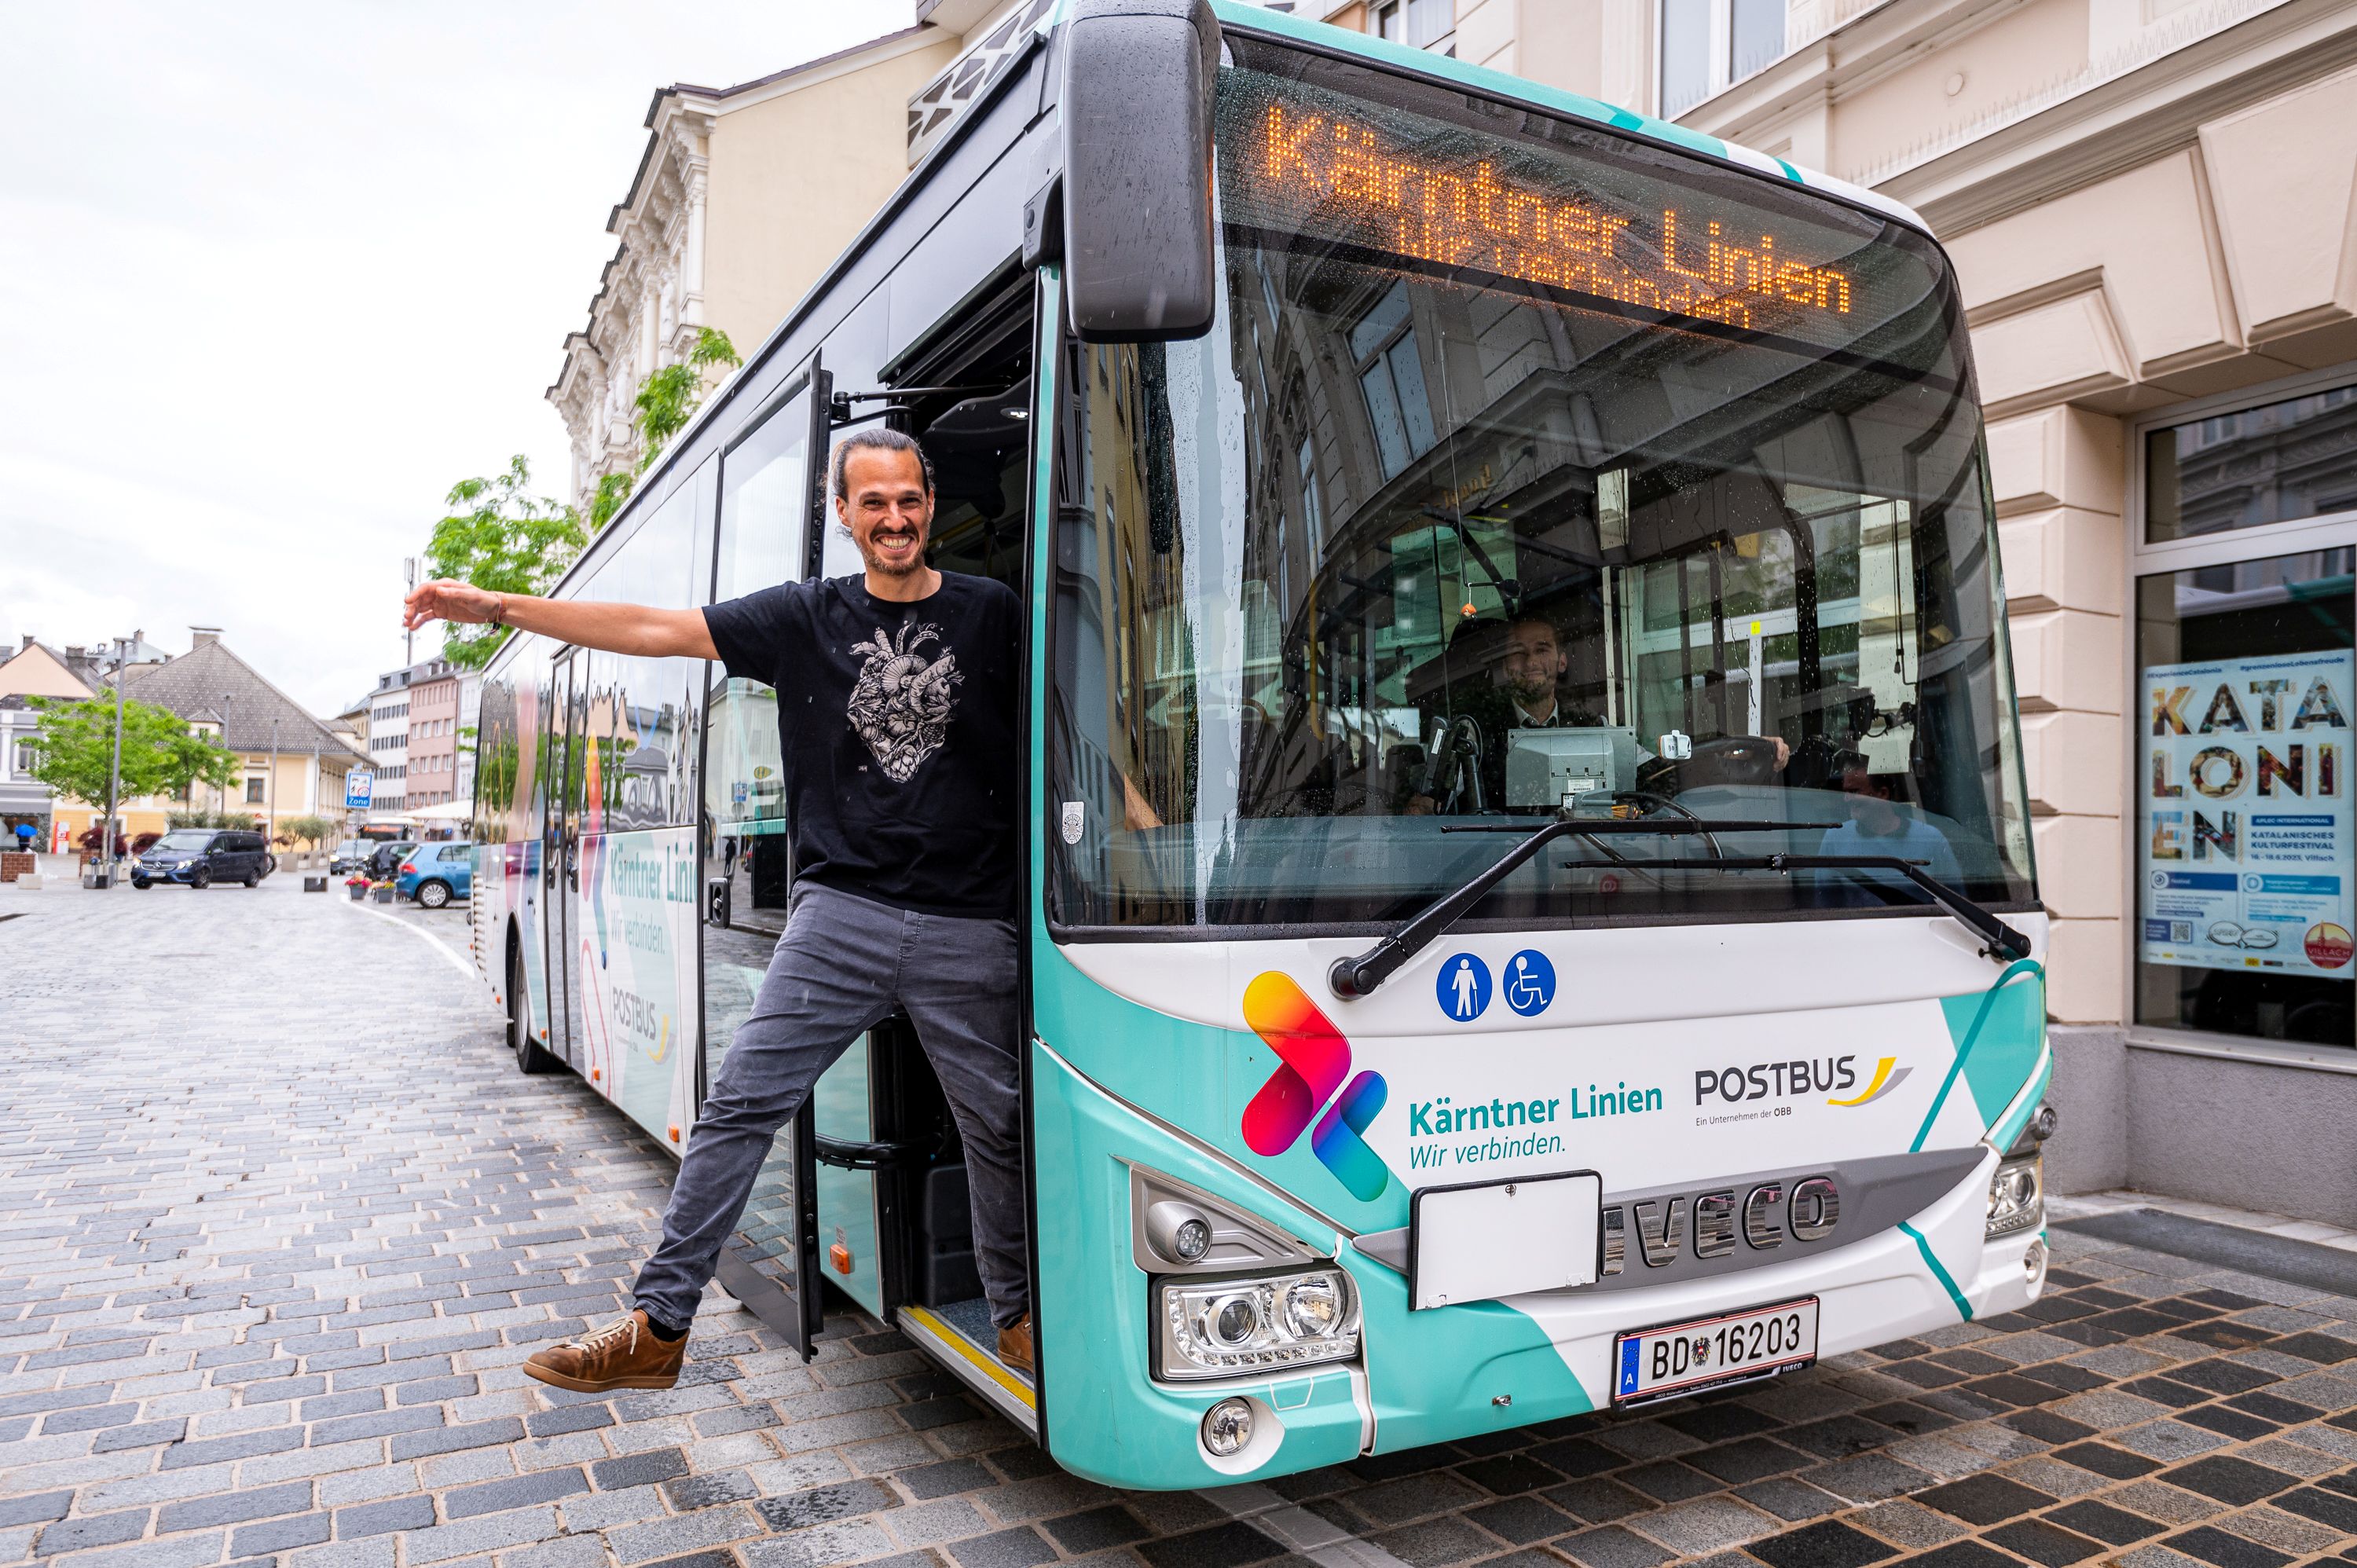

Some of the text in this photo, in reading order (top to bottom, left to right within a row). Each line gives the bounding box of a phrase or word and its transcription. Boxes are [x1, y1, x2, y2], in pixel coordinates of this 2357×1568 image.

[1266, 104, 1852, 314] Kärntner Linien
[2152, 676, 2349, 737] KATA
[2152, 742, 2337, 799] LONI
[2152, 809, 2238, 861] EN
[2250, 841, 2334, 850] KULTURFESTIVAL
[610, 844, 662, 900] Kärntner
[610, 910, 665, 955] Wir verbinden.
[2307, 948, 2351, 957] VILLACH
[613, 986, 657, 1041] POSTBUS
[1695, 1054, 1856, 1106] POSTBUS
[1409, 1081, 1662, 1137] Kärntner Linien
[1695, 1106, 1792, 1127] Ein Unternehmen der ÖBB
[1410, 1132, 1566, 1170] Wir verbinden.
[1600, 1174, 1840, 1277] IVECO
[1651, 1313, 1801, 1380] BD 16203
[1782, 1362, 1803, 1373] IVECO
[1625, 1372, 1634, 1386] A
